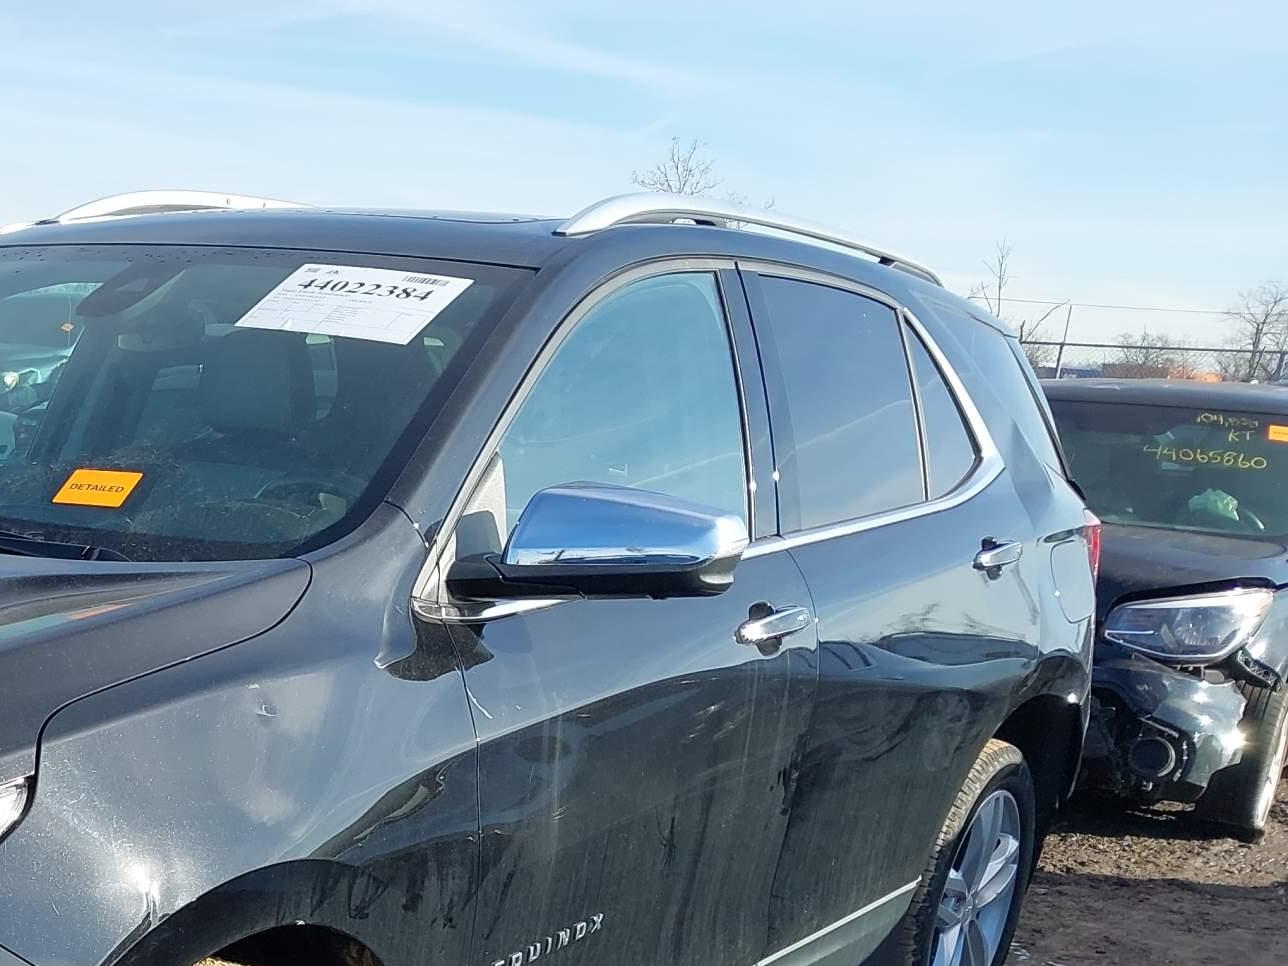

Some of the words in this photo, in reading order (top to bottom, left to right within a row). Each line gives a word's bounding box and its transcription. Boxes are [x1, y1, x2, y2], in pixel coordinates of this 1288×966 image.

[297, 278, 435, 302] 44022384
[1143, 444, 1267, 469] 44065860
[69, 483, 124, 493] DETAILED
